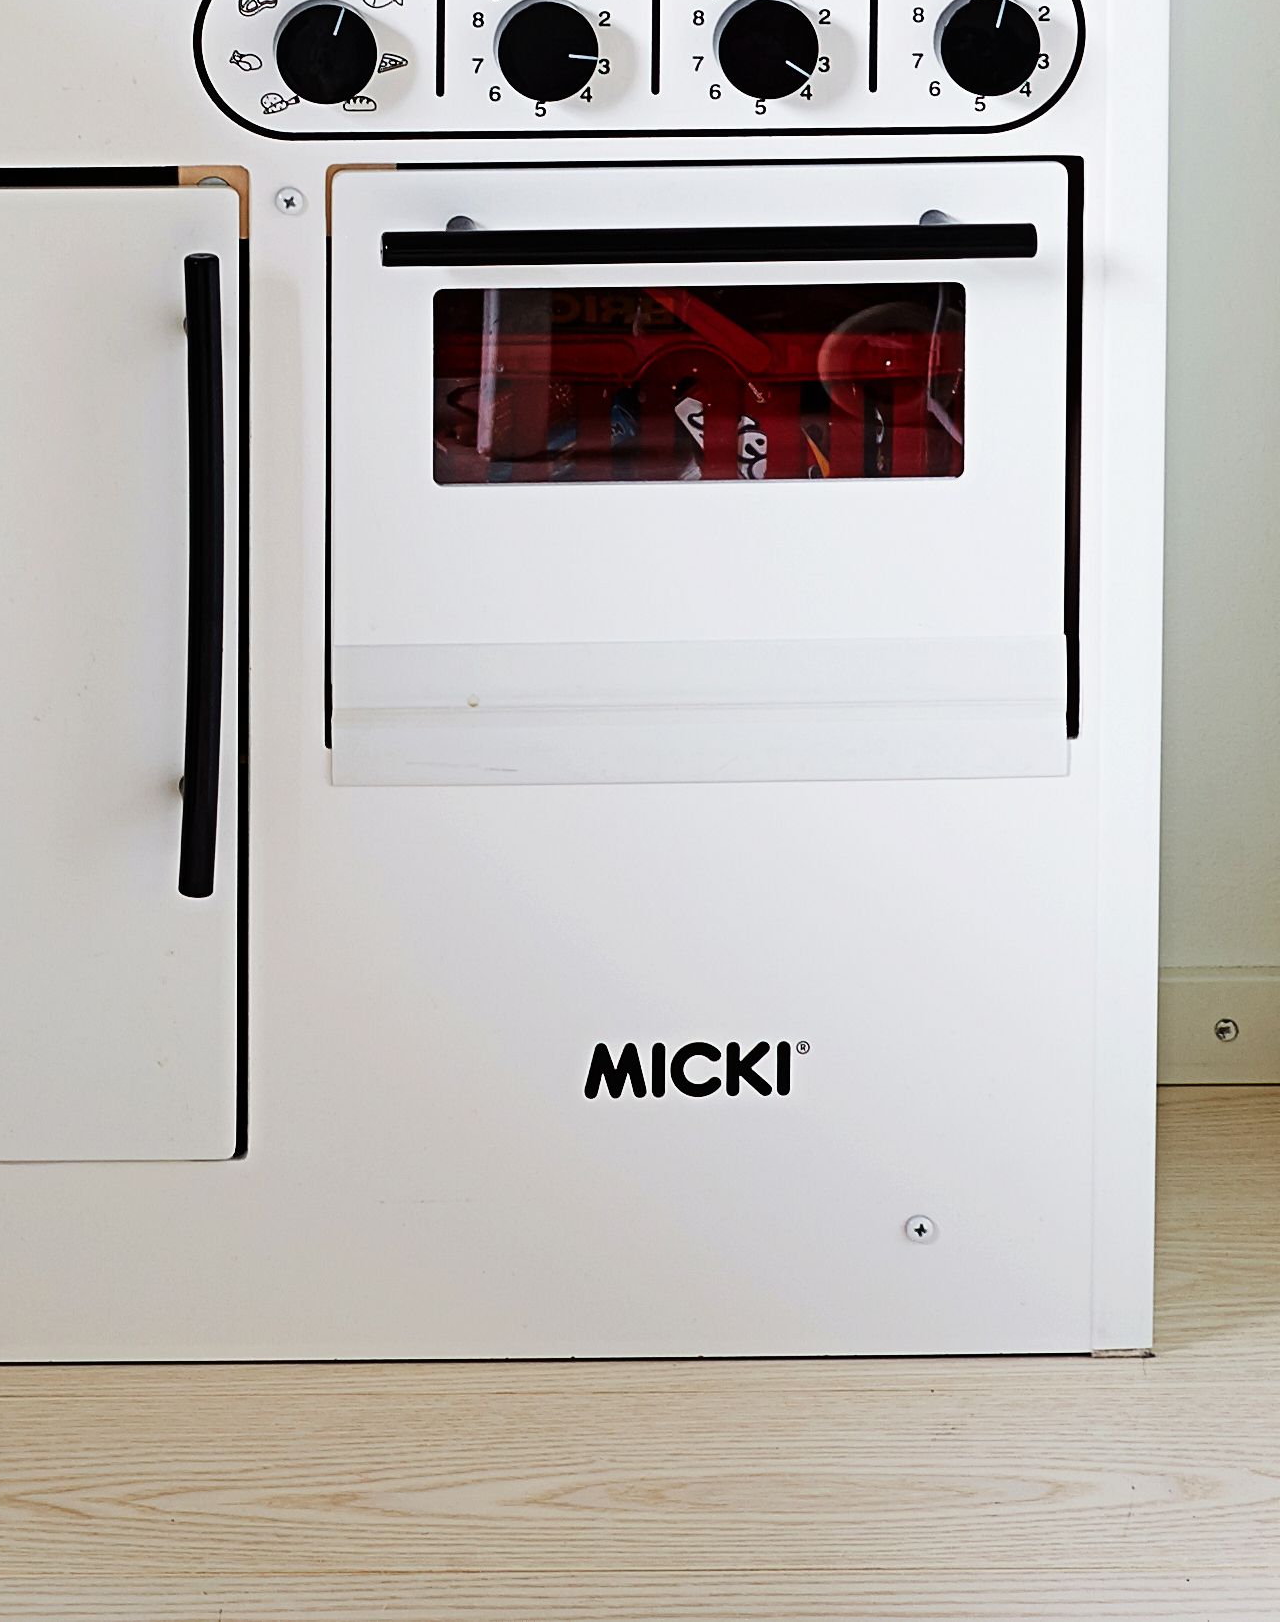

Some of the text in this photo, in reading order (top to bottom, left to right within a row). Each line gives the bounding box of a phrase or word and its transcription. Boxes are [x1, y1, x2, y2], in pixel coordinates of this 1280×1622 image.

[473, 12, 484, 28] 8
[599, 11, 611, 26] 2
[693, 10, 704, 26] 8
[819, 9, 831, 24] 2
[912, 7, 924, 23] 8
[1038, 6, 1050, 21] 2
[472, 58, 484, 74] 7
[598, 59, 610, 74] 3
[693, 56, 704, 71] 7
[818, 56, 830, 72] 3
[912, 53, 923, 68] 7
[1038, 53, 1049, 69] 3
[489, 86, 501, 101] 6
[580, 87, 592, 102] 4
[710, 84, 721, 99] 6
[800, 85, 812, 100] 4
[929, 81, 941, 96] 6
[1020, 82, 1032, 97] 4
[535, 101, 546, 117] 5
[755, 98, 766, 115] 5
[974, 96, 986, 112] 5
